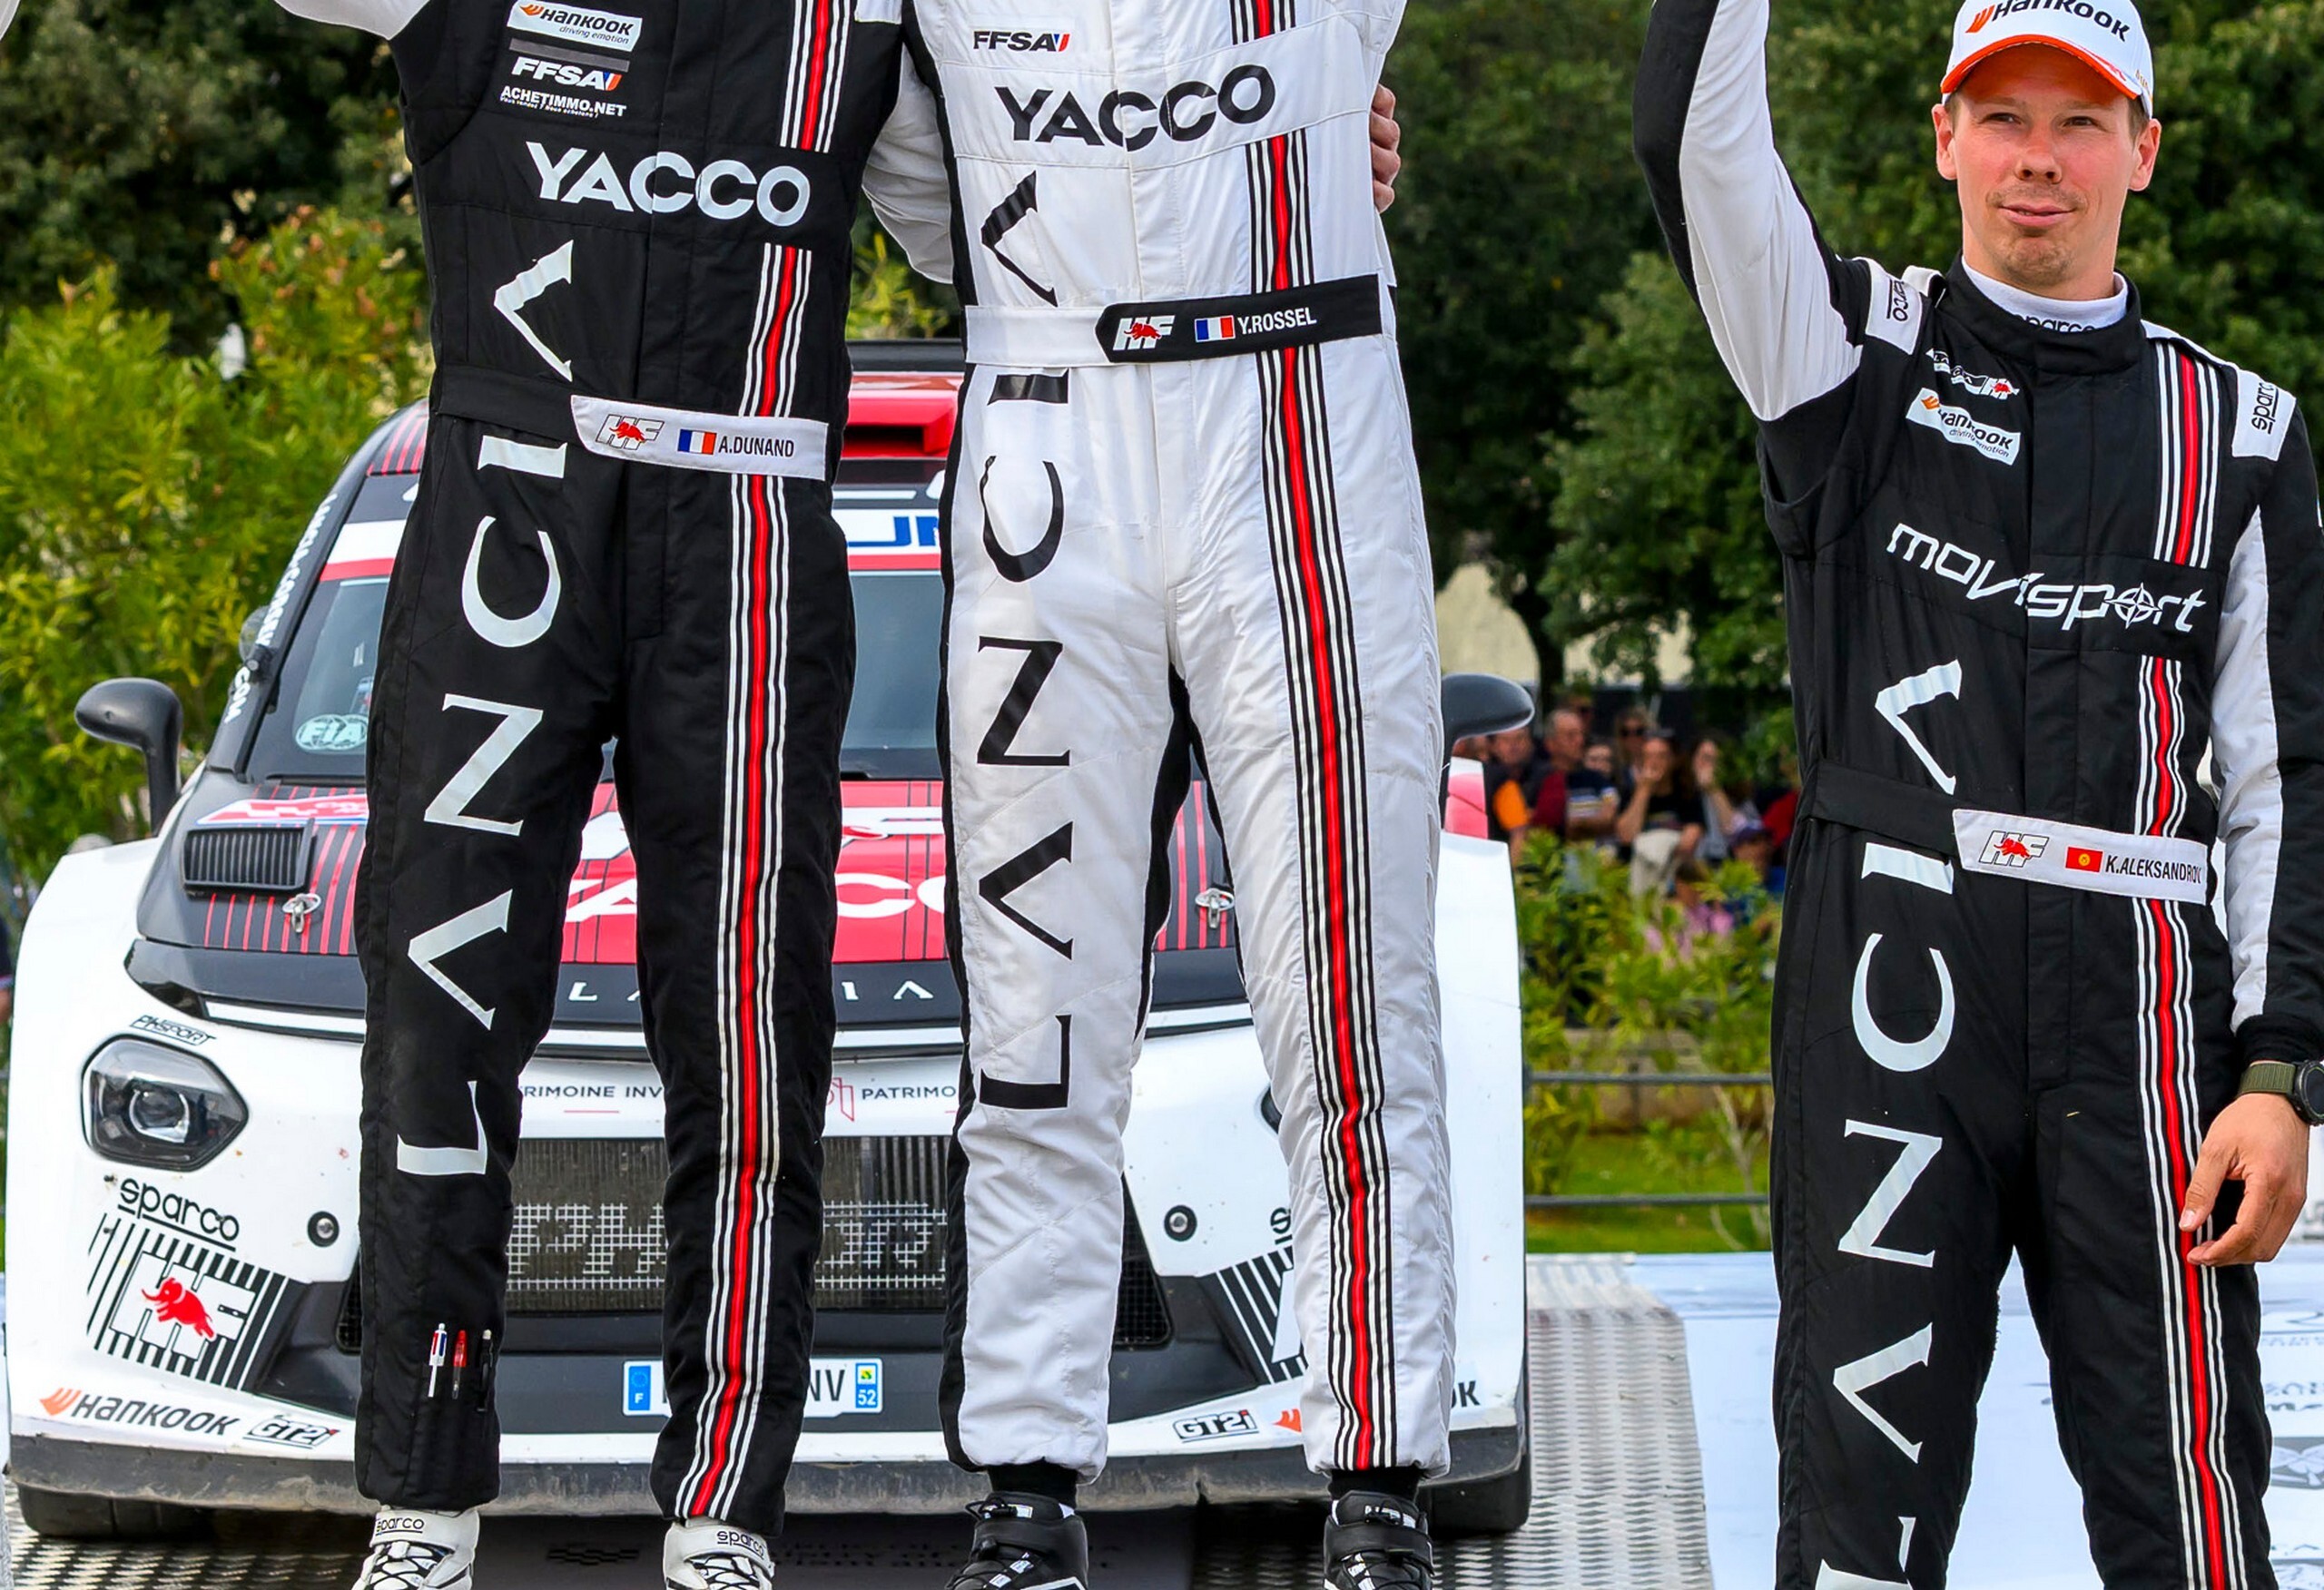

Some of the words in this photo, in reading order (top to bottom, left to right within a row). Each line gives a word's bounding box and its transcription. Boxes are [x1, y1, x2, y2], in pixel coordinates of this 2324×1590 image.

[559, 25, 590, 38] driving
[591, 33, 629, 44] emotion
[973, 30, 1059, 52] FFSA
[511, 56, 606, 91] FFSA
[501, 85, 626, 117] ACHETIMMO.NET
[994, 64, 1275, 152] YACCO
[527, 141, 811, 227] YACCO
[1237, 308, 1317, 335] Y.ROSSEL
[718, 436, 794, 457] A.DUNAND
[862, 1085, 957, 1100] PATRIMO
[119, 1178, 240, 1243] sparco
[858, 1389, 876, 1406] 52
